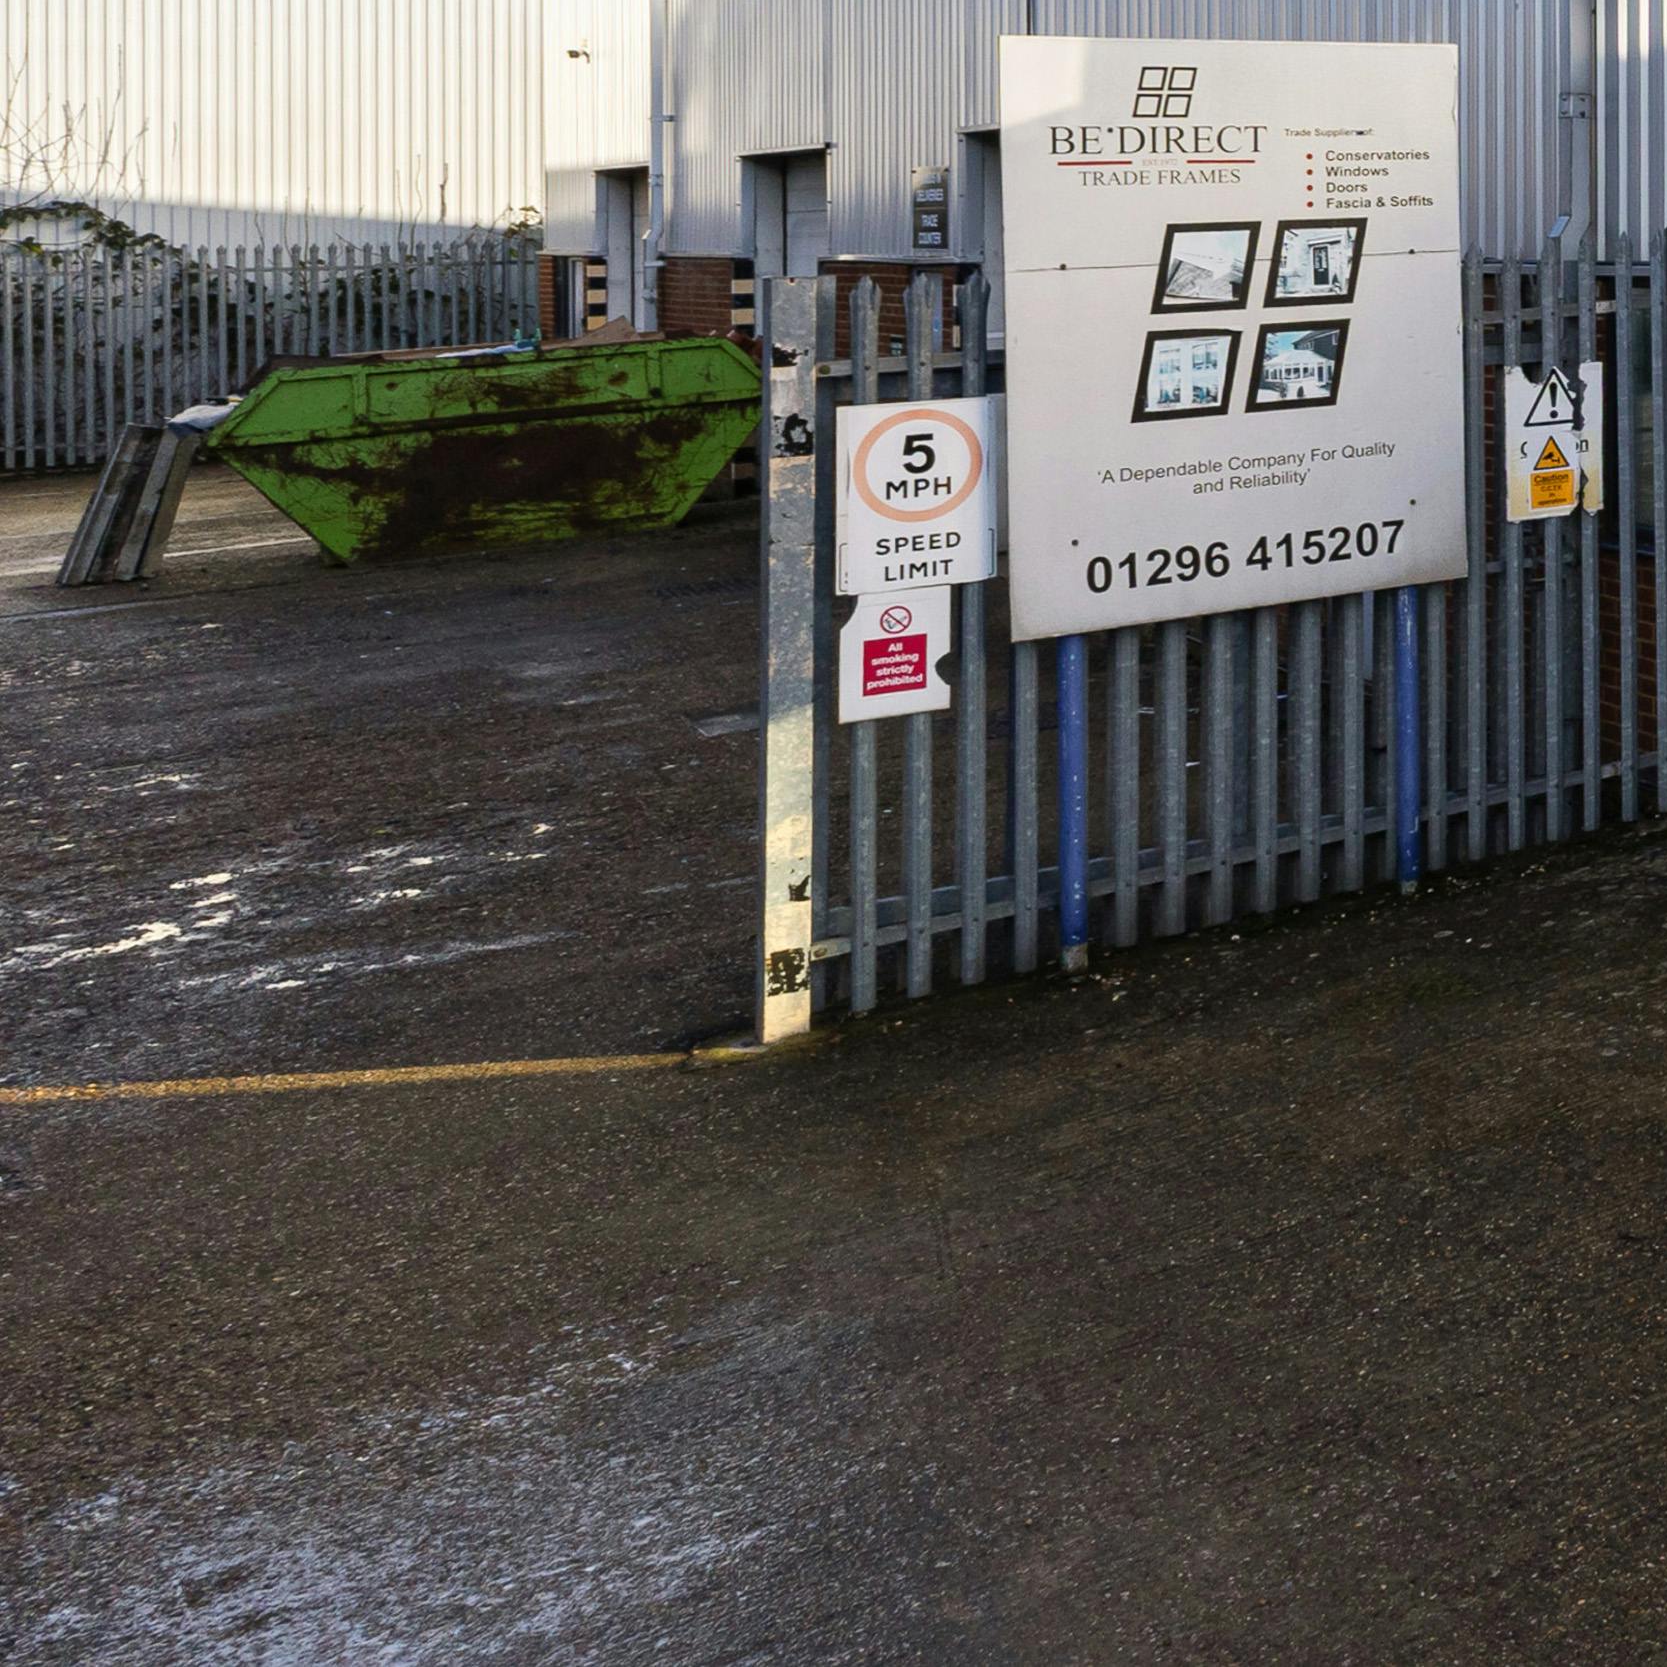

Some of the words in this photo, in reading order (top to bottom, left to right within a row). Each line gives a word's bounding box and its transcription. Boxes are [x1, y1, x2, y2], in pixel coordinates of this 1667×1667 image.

[1284, 128, 1312, 137] Trade
[1325, 149, 1430, 162] Conservatories
[1078, 170, 1152, 187] TRADE
[1157, 168, 1241, 186] FRAMES
[1325, 166, 1389, 177] Windows
[1325, 182, 1368, 193] Doors
[1326, 197, 1371, 209] Fascia
[1376, 196, 1386, 207] &
[1390, 195, 1434, 207] Soffits
[902, 433, 936, 475] 5
[1119, 459, 1223, 486] Dependable
[1228, 451, 1305, 473] Company
[1310, 446, 1338, 463] For
[1341, 441, 1396, 459] Quality
[885, 476, 952, 501] MPH
[1193, 480, 1225, 495] and
[875, 531, 961, 556] SPEED
[1086, 540, 1231, 594] 01296
[1245, 519, 1405, 572] 415207
[884, 559, 953, 582] LIMIT
[888, 642, 904, 653] All
[871, 653, 919, 667] smoking
[876, 664, 914, 677] strictly
[867, 673, 923, 691] prohibited
